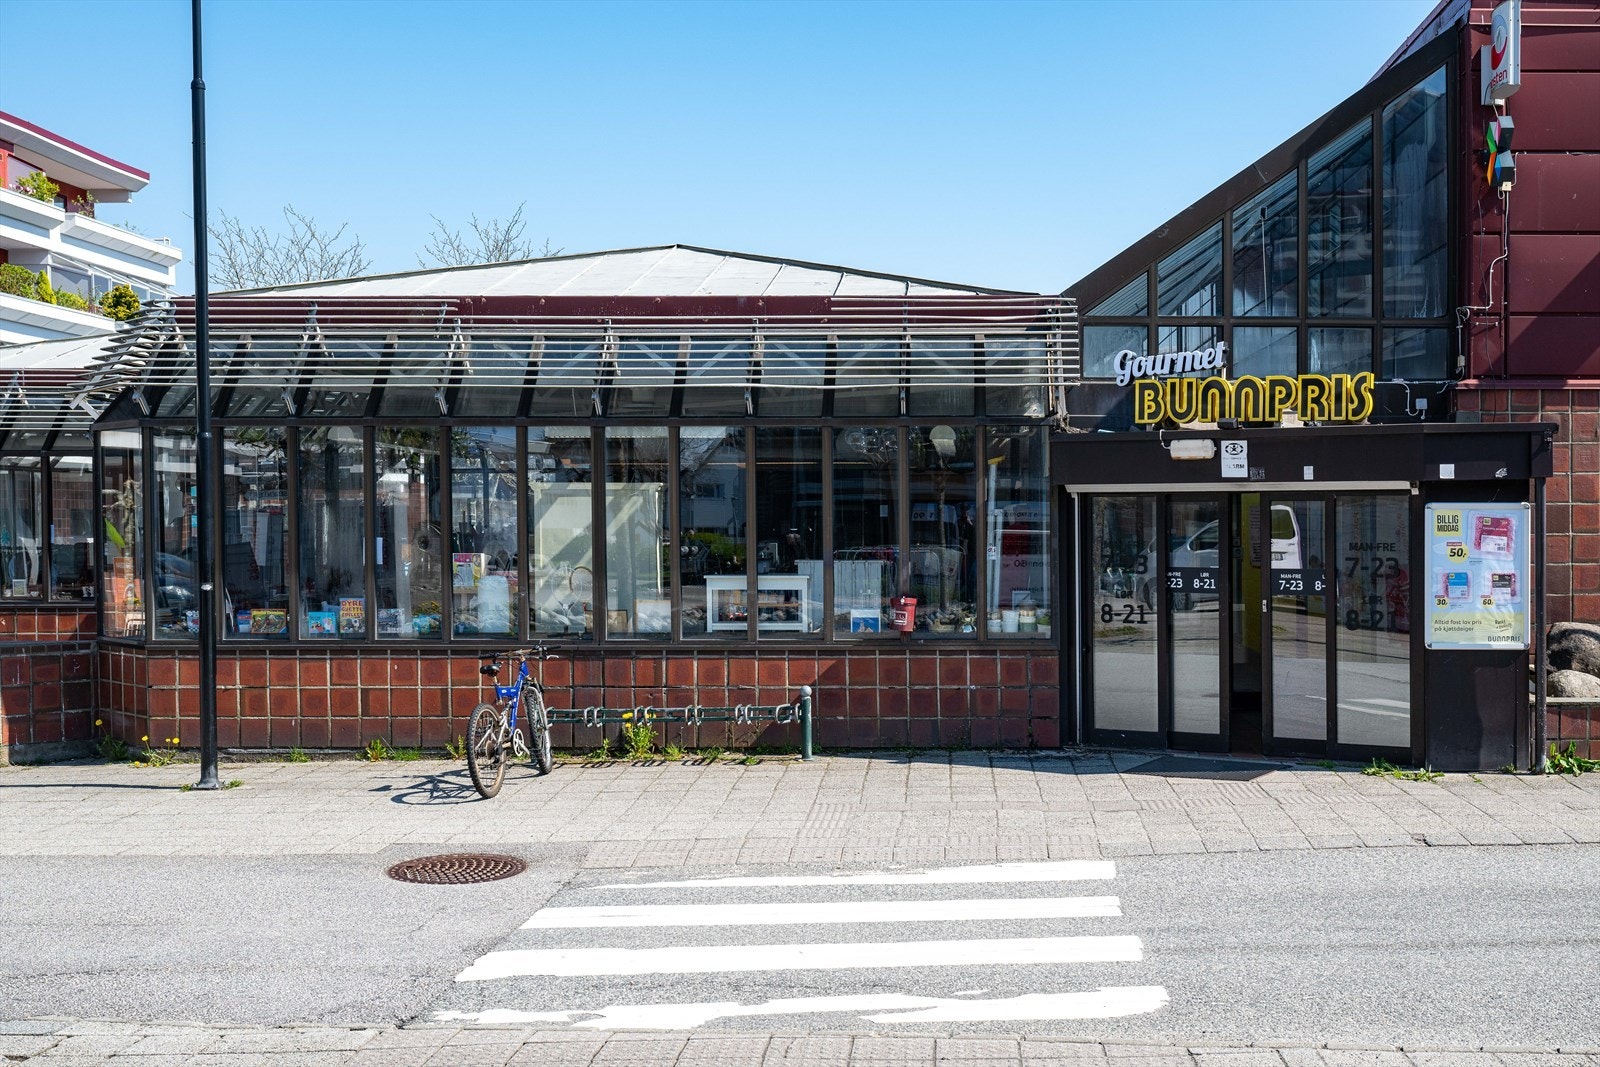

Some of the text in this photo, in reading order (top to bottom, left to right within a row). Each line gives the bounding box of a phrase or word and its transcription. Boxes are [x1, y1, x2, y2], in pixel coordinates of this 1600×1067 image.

[1113, 341, 1227, 387] Gourmet
[1134, 372, 1374, 424] BUNNPRIS
[1436, 514, 1459, 524] BILLIG
[1436, 524, 1459, 532] MIDDAG
[1349, 542, 1396, 552] MAN-FRE
[1345, 557, 1400, 578] 7-23
[1193, 578, 1216, 589] 8-21
[1278, 580, 1304, 591] 7-23
[1101, 603, 1148, 624] 8-21
[1346, 609, 1396, 632] 8-21
